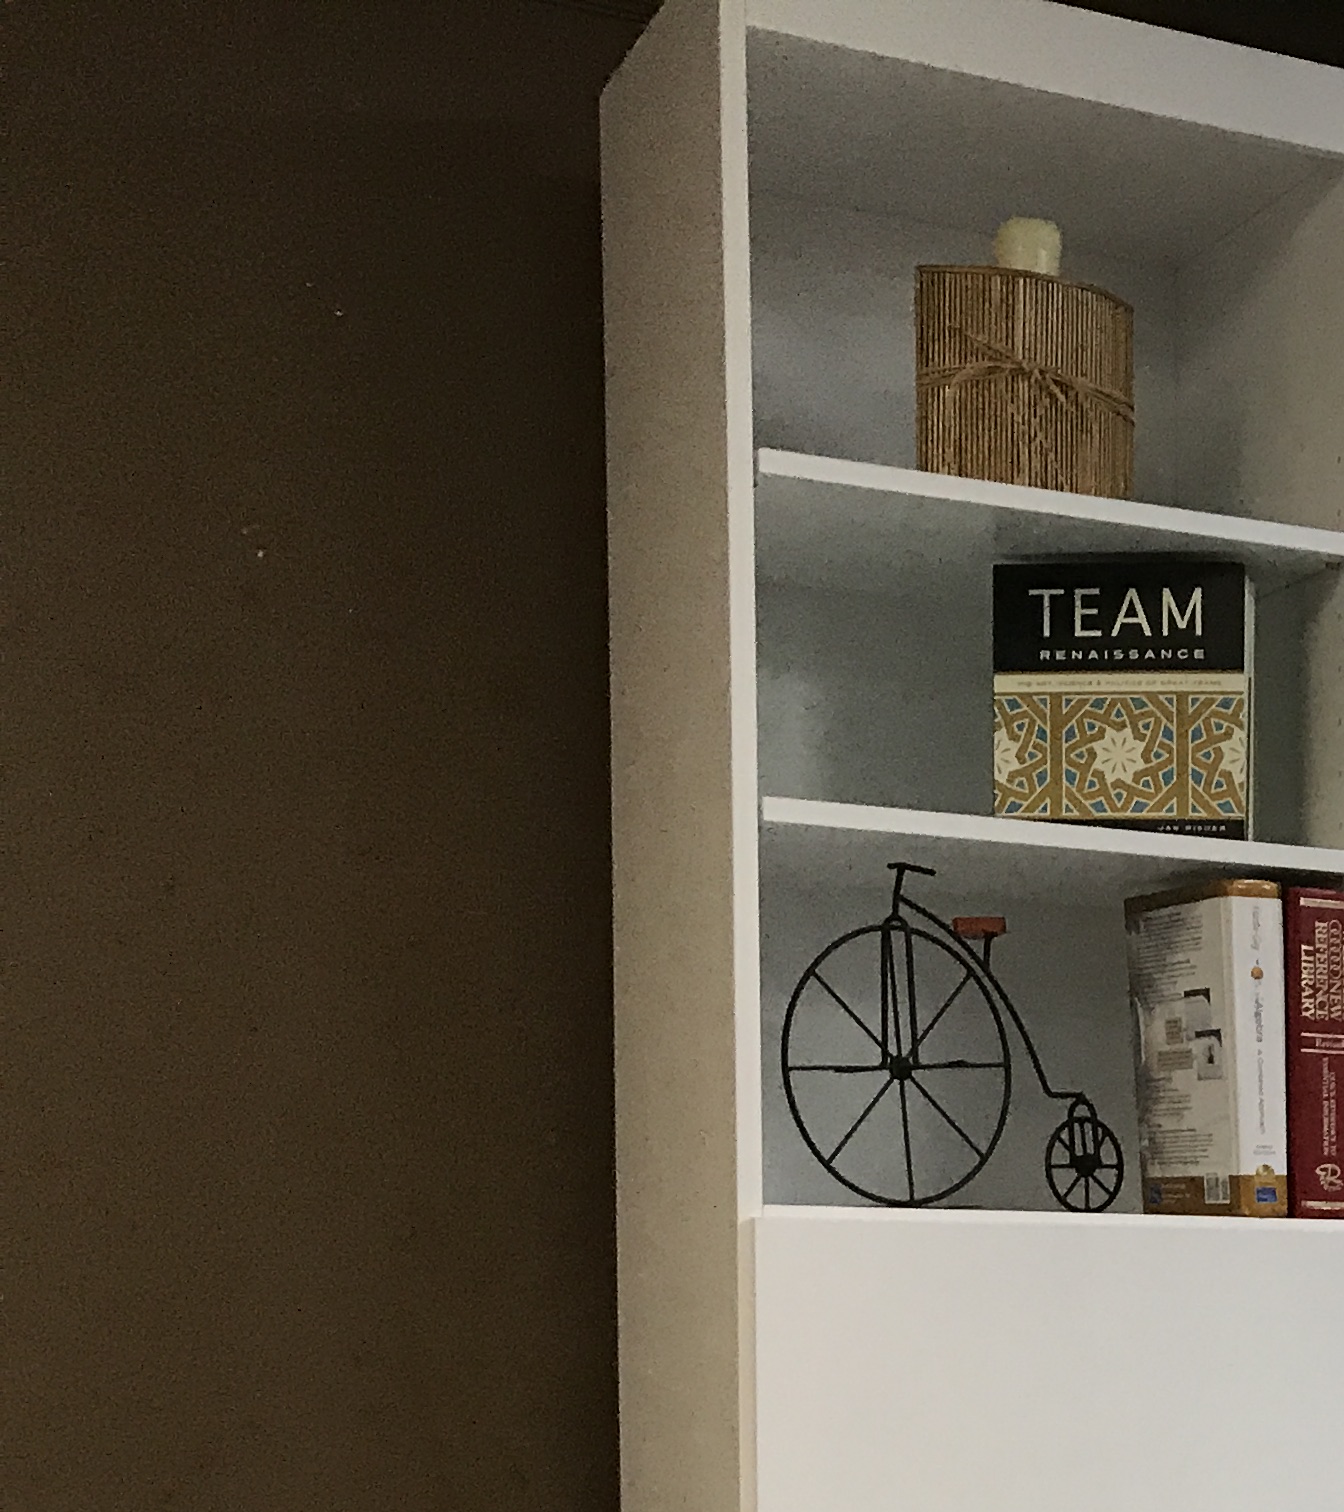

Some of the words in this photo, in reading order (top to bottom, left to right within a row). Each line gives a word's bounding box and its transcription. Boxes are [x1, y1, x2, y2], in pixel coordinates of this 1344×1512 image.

[1028, 586, 1203, 638] TEAM
[1039, 648, 1205, 661] RENAISSANCE
[1300, 944, 1315, 1021] LIBRARY
[1315, 920, 1329, 1021] REFERENCE
[1330, 979, 1342, 1022] NEW
